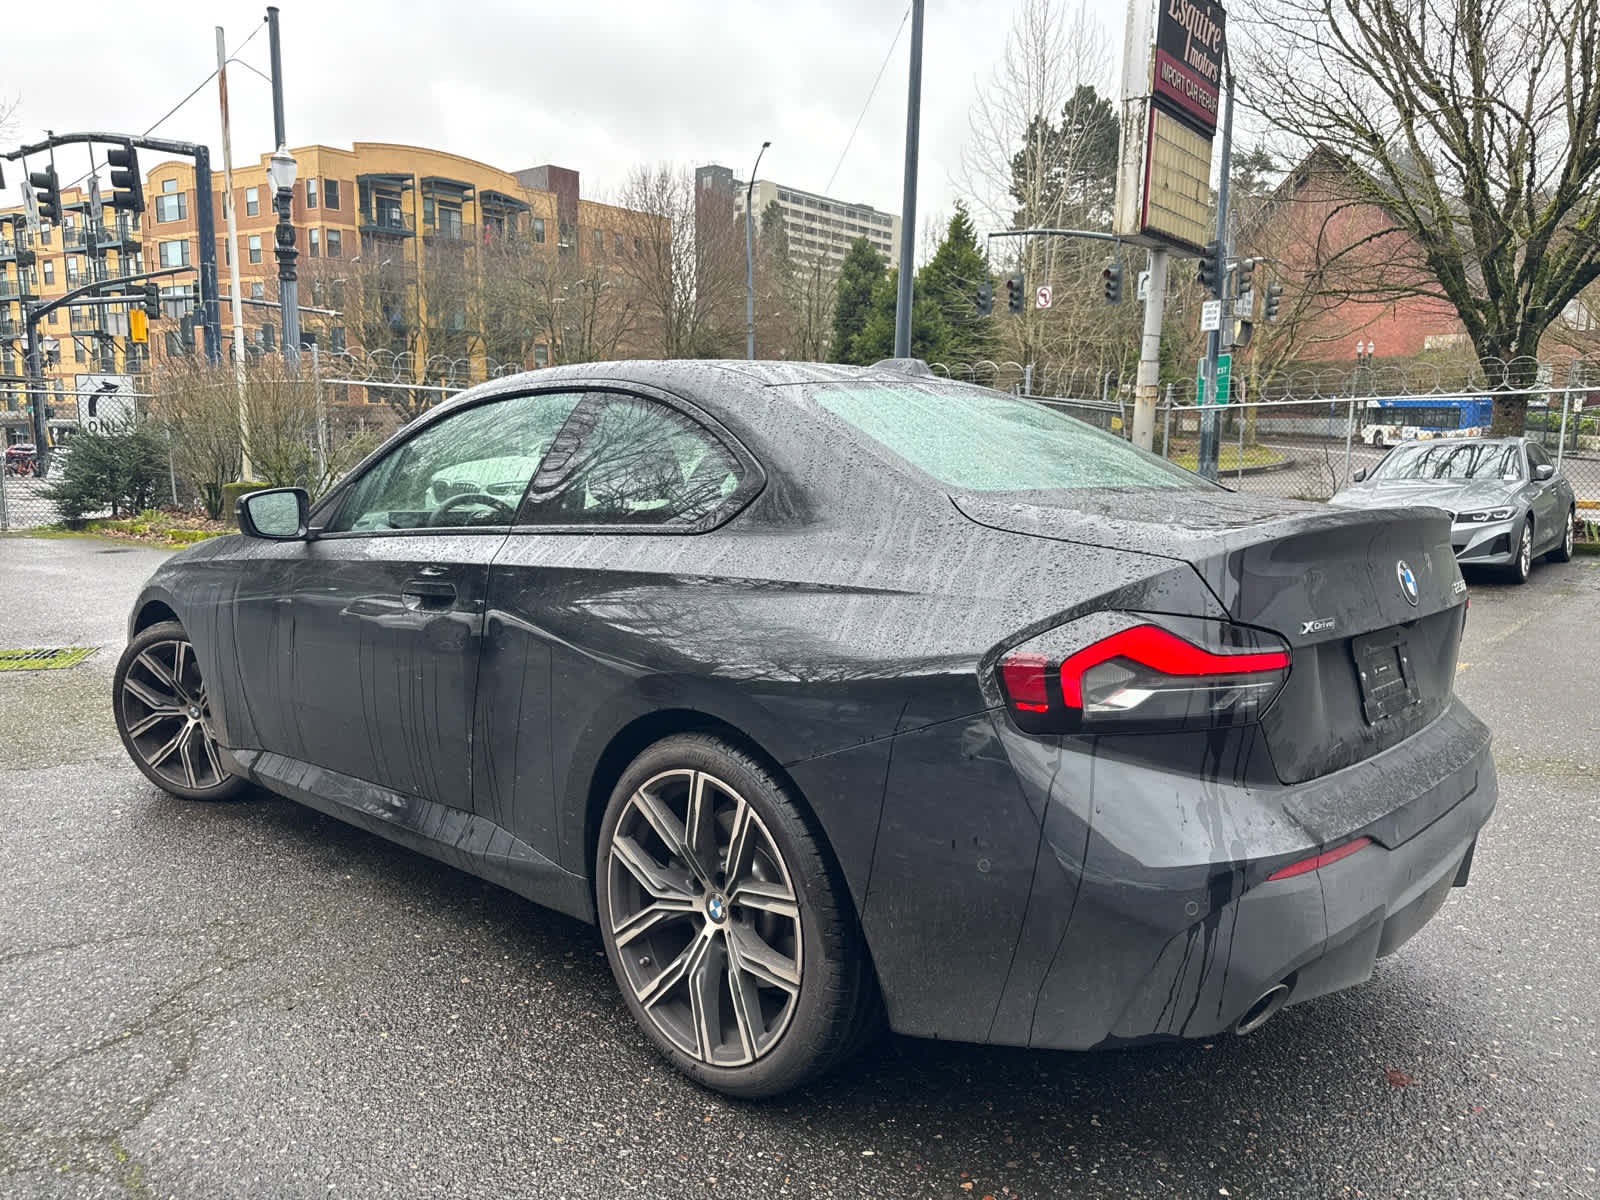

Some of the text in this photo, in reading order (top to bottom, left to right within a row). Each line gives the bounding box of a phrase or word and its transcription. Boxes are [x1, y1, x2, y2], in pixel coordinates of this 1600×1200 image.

[1189, 47, 1218, 82] motors
[1162, 61, 1217, 114] IMPORT CAR REPAIR
[89, 420, 130, 433] ONLY
